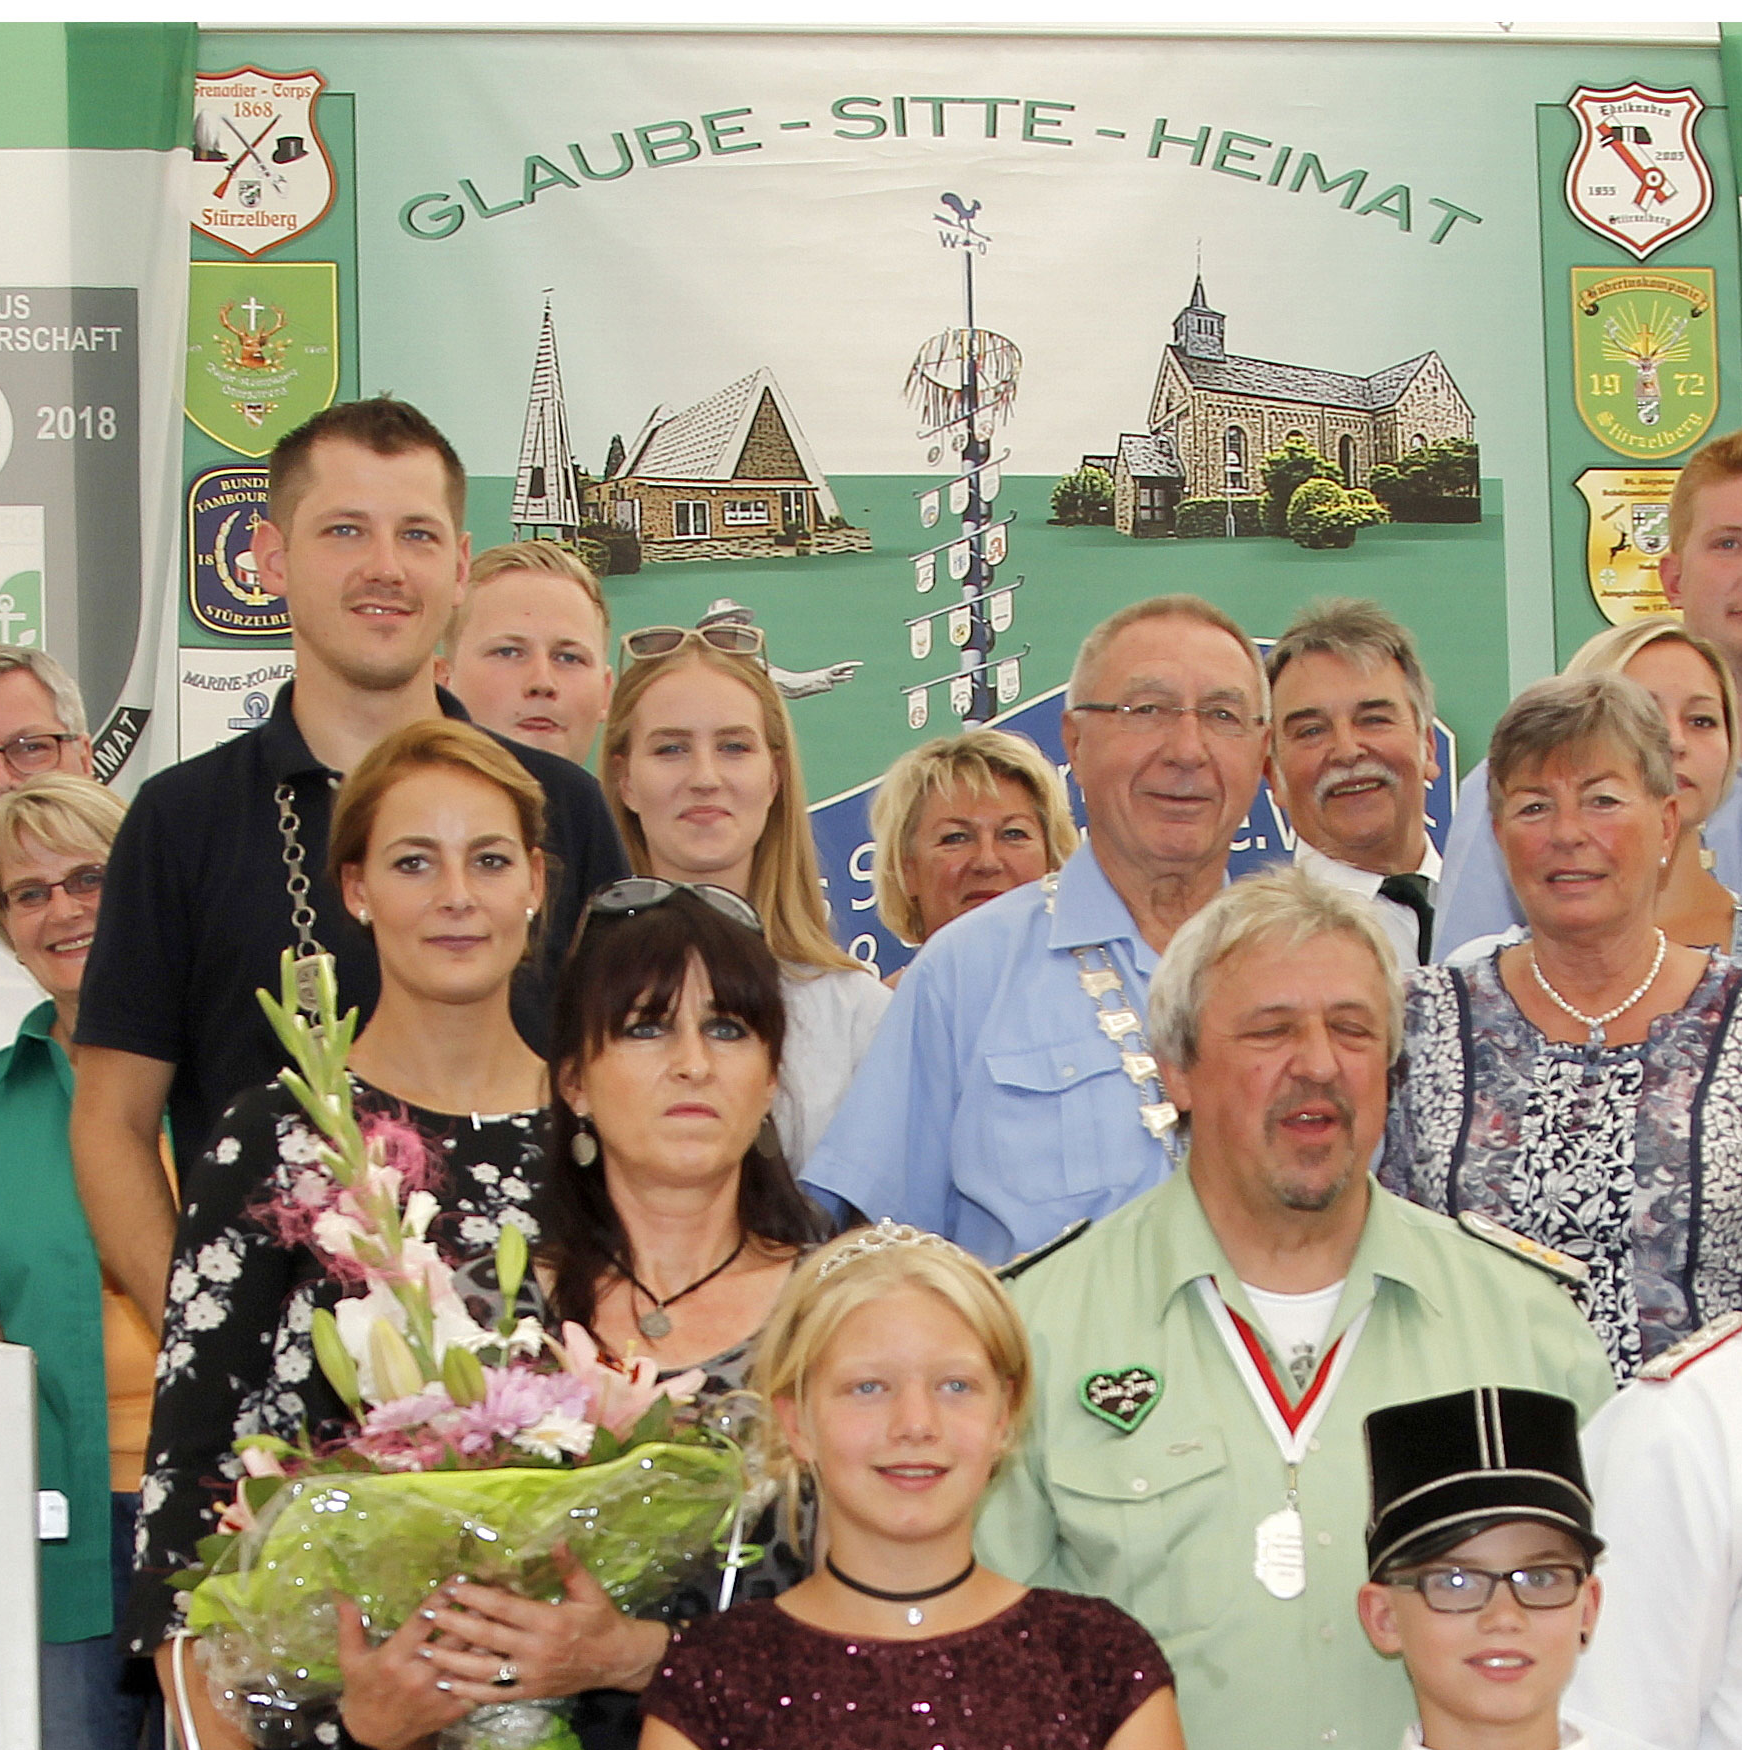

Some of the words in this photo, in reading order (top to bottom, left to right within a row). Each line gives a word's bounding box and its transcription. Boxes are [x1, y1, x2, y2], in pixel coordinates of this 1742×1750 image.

[234, 102, 273, 118] 1868
[398, 106, 763, 241] GLAUBE
[831, 96, 1076, 148] SITTE
[1149, 117, 1482, 246] HEIMAT
[202, 209, 297, 230] Stürzelberg
[939, 231, 958, 248] W
[1589, 373, 1621, 396] 19
[1673, 373, 1705, 397] 72
[37, 406, 117, 441] 2018
[196, 492, 271, 513] TAMBOUR
[198, 554, 214, 566] 18
[204, 605, 292, 626] STÜRZELBE
[183, 664, 297, 691] MARINE-KOMP
[91, 710, 138, 783] IMAT
